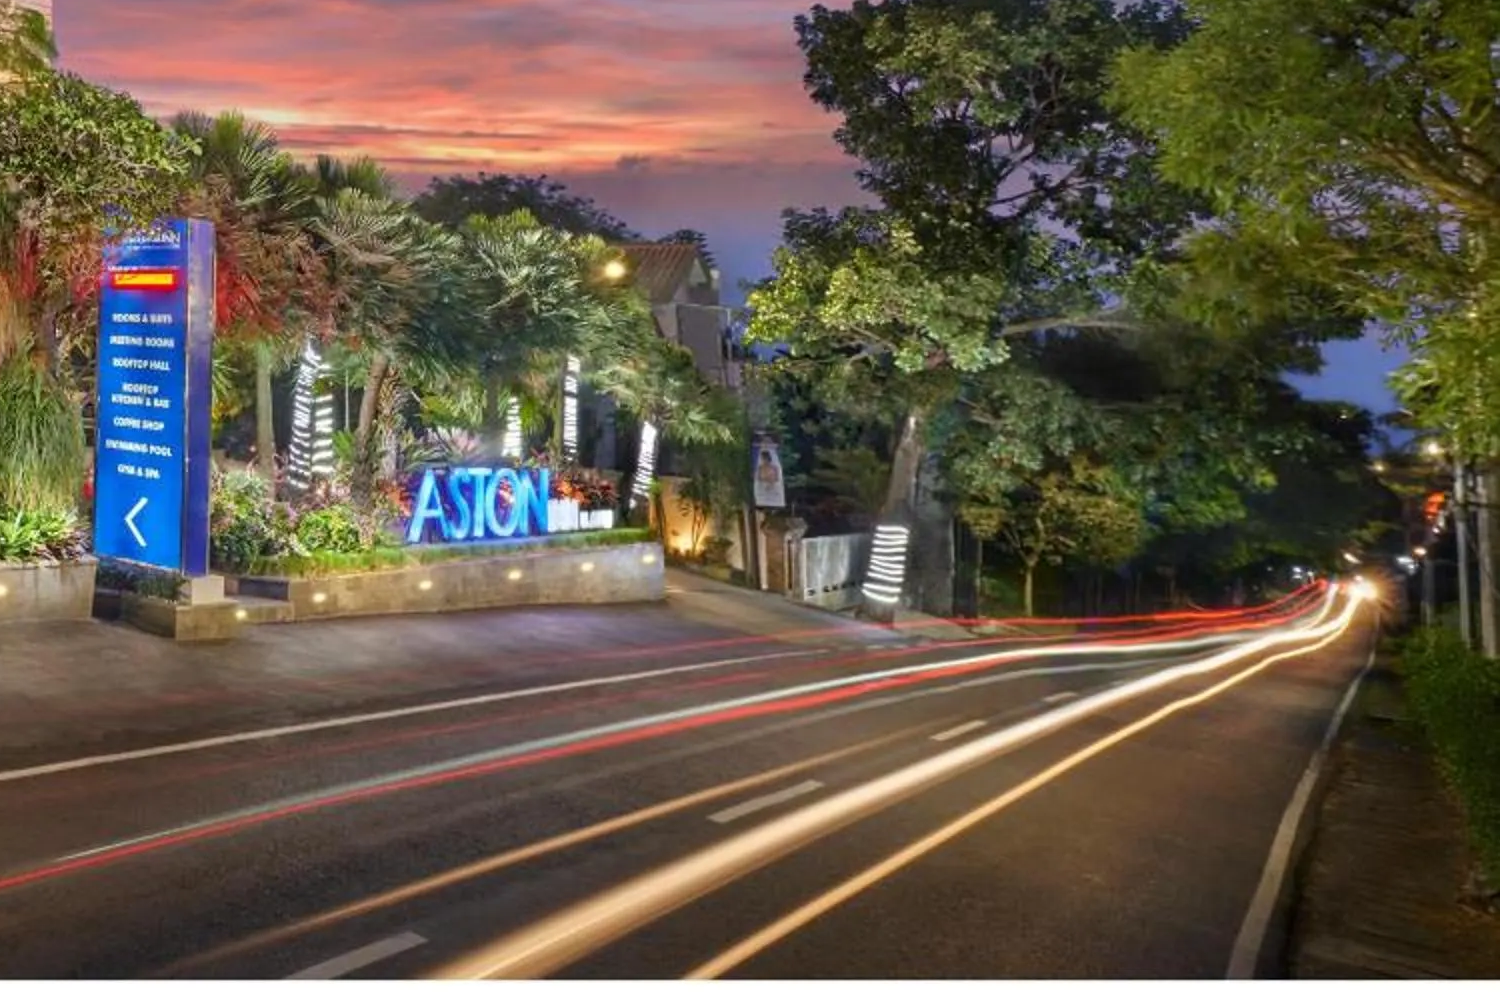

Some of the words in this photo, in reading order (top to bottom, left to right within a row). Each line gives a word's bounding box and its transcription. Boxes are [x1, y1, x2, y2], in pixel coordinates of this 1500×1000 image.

[112, 313, 141, 324] ROOMS
[109, 335, 143, 346] MEETING
[145, 336, 175, 348] ROOMS
[112, 357, 148, 370] ROOFTOP
[149, 360, 170, 371] HALL
[122, 382, 159, 395] ROOFTOP
[111, 393, 144, 405] KITCHEN
[113, 416, 141, 429] COFFEE
[142, 419, 165, 431] SHOP
[105, 439, 148, 453] SWIMMING
[149, 445, 173, 457] POOL
[145, 467, 161, 479] SPA
[406, 467, 549, 544] ASTON
